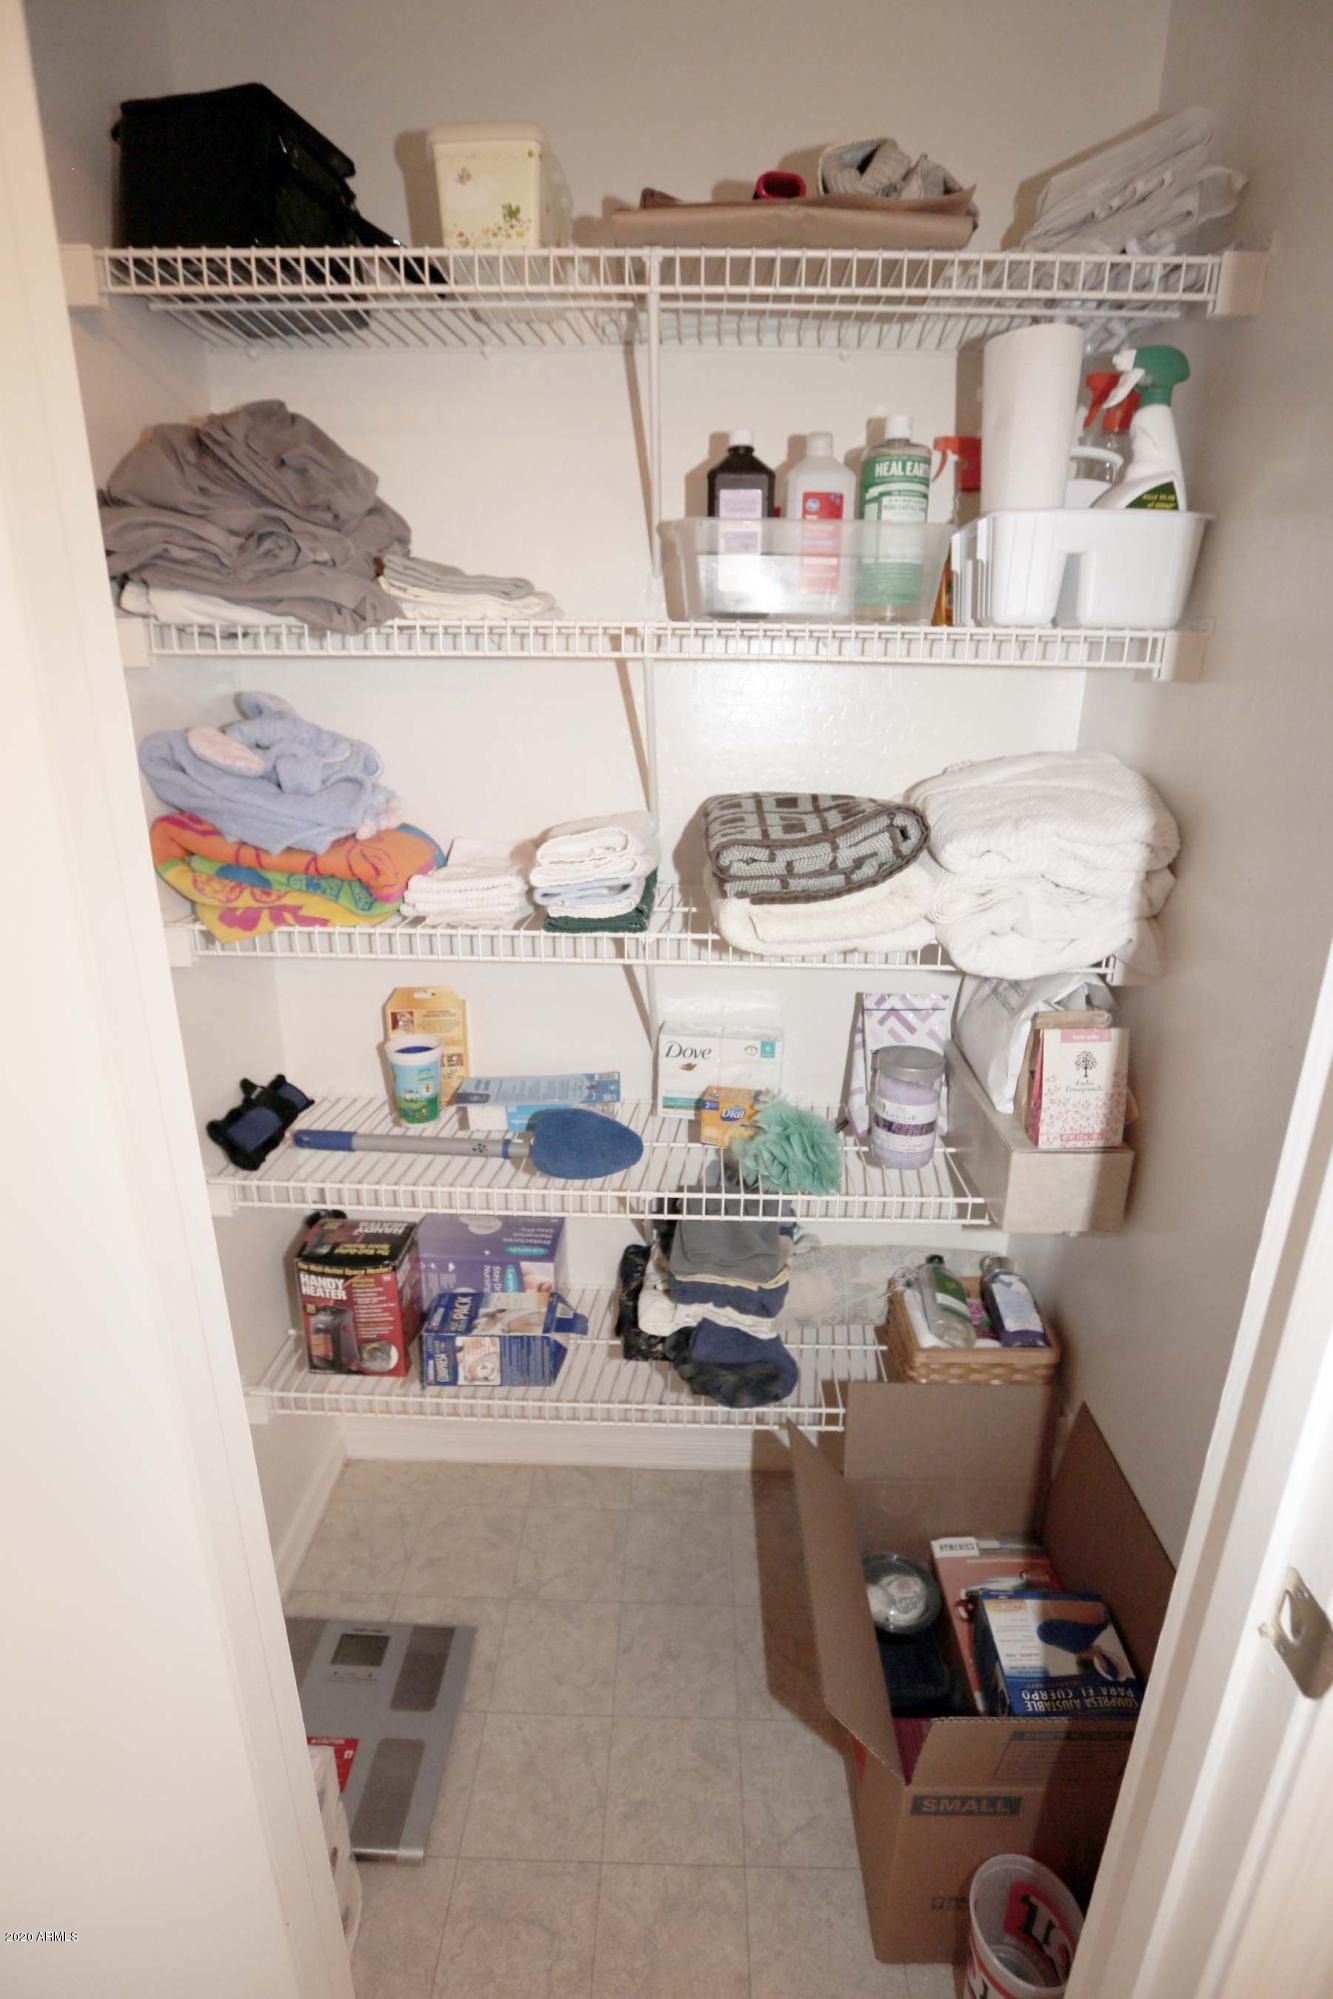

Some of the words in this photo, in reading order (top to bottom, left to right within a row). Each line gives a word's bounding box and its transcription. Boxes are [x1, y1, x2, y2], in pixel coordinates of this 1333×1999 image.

[875, 460, 905, 478] HEAL
[664, 1039, 712, 1060] Dove
[720, 1107, 746, 1121] Dial
[299, 1272, 345, 1290] HANDY
[301, 1285, 347, 1301] HEATER
[452, 1296, 474, 1320] PACK
[1021, 1688, 1073, 1701] CUERPO
[1079, 1687, 1094, 1697] EL
[1024, 1698, 1080, 1712] AJUSTABLE
[920, 1798, 1011, 1812] SMALL
